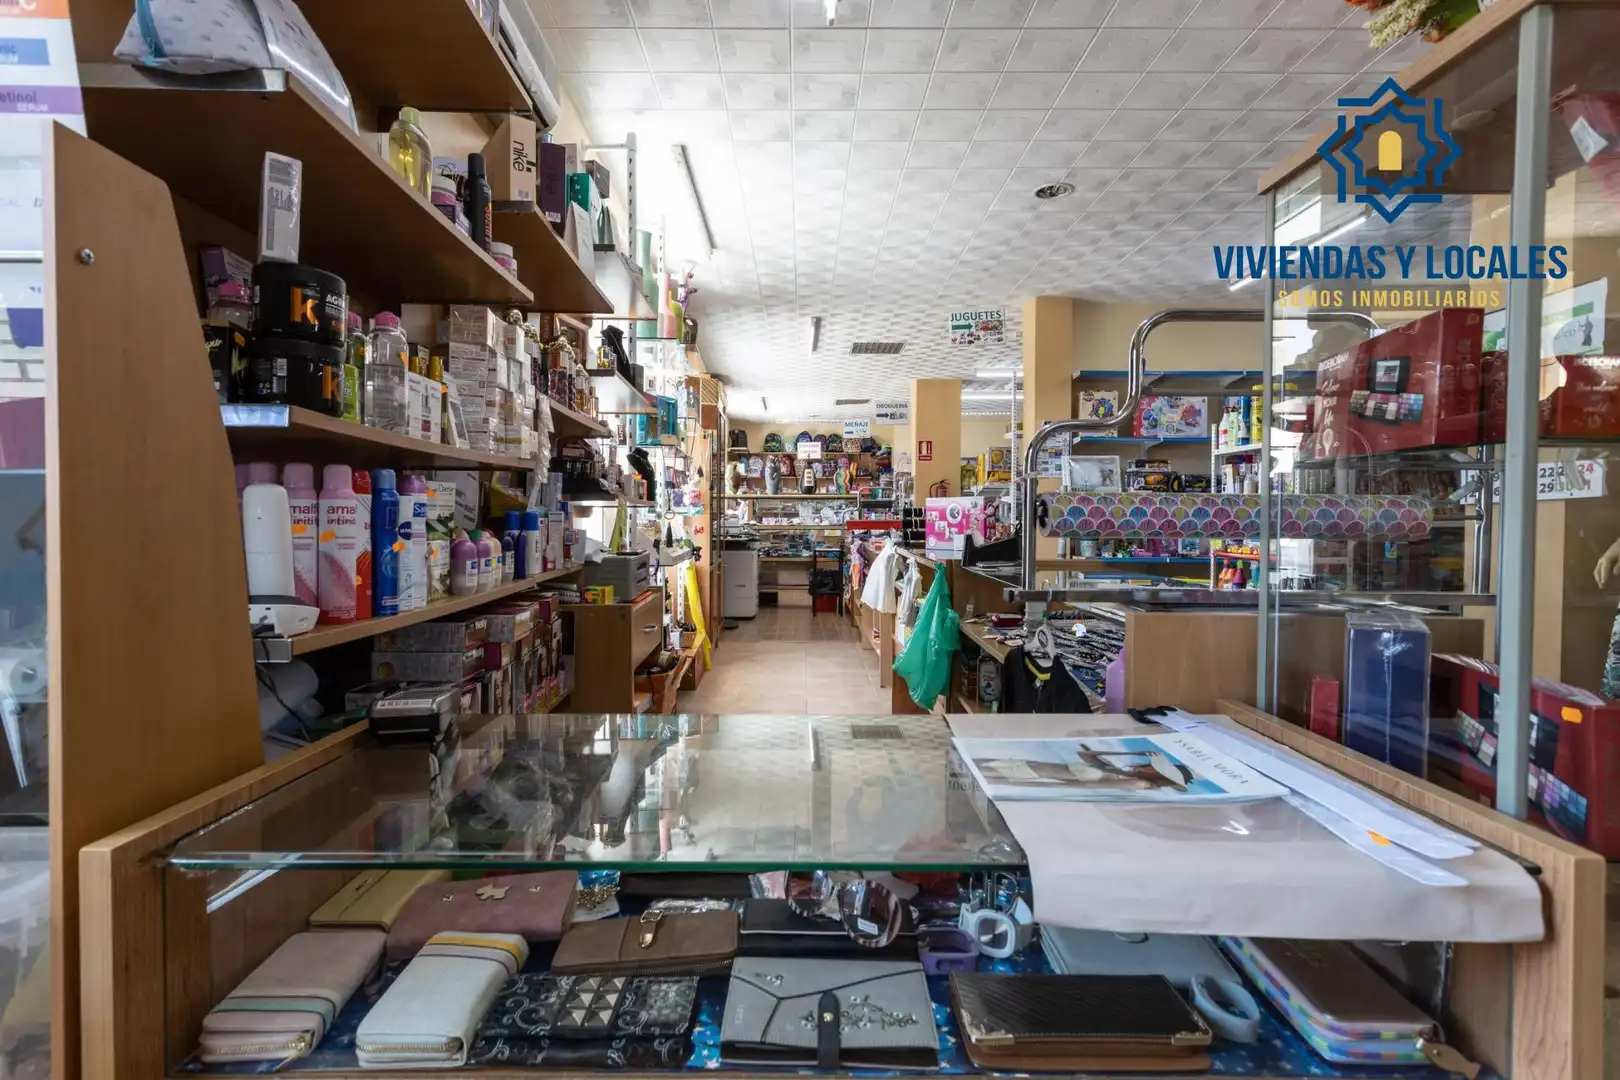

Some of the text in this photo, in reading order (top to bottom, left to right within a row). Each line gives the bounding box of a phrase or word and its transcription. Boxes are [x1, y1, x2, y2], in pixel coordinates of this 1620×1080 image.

[951, 311, 1002, 322] JUGUETES
[1540, 467, 1555, 478] 22
[1540, 482, 1554, 493] 29
